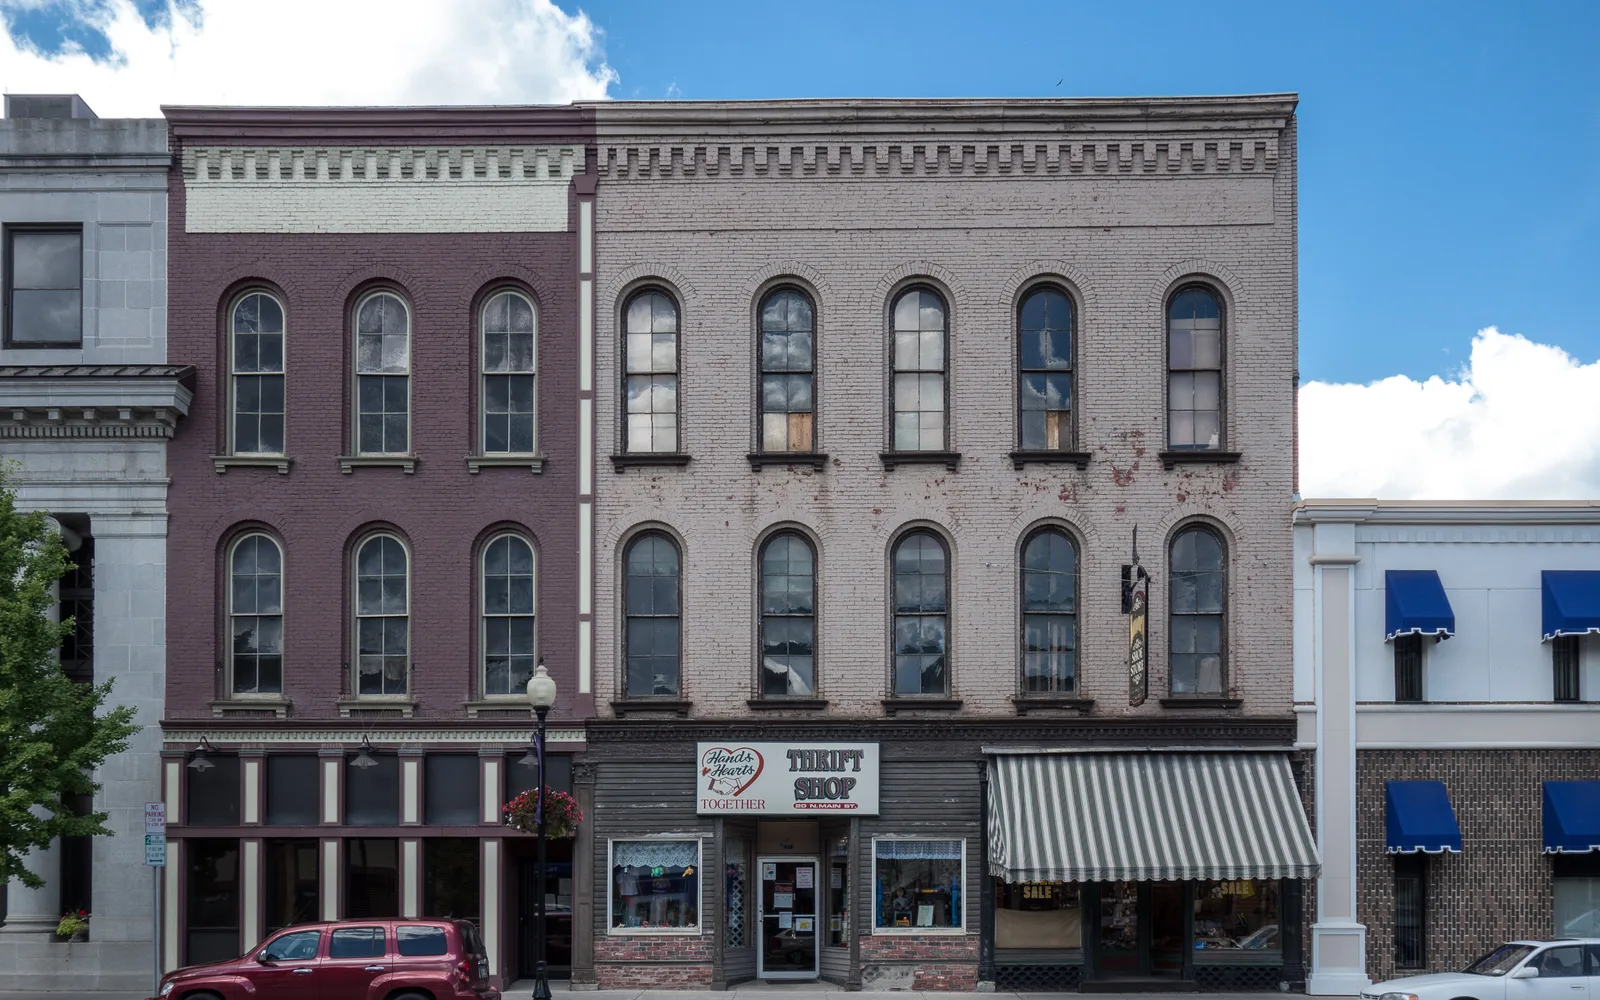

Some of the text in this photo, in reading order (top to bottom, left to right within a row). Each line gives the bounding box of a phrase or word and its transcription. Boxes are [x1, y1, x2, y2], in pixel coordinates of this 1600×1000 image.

[707, 750, 754, 764] Hands
[786, 749, 864, 772] THRIFT
[711, 764, 755, 777] Hearts
[794, 777, 857, 800] SHOP
[701, 799, 766, 809] TOGETHER
[1023, 886, 1052, 898] SALE
[1221, 882, 1249, 894] SALE
